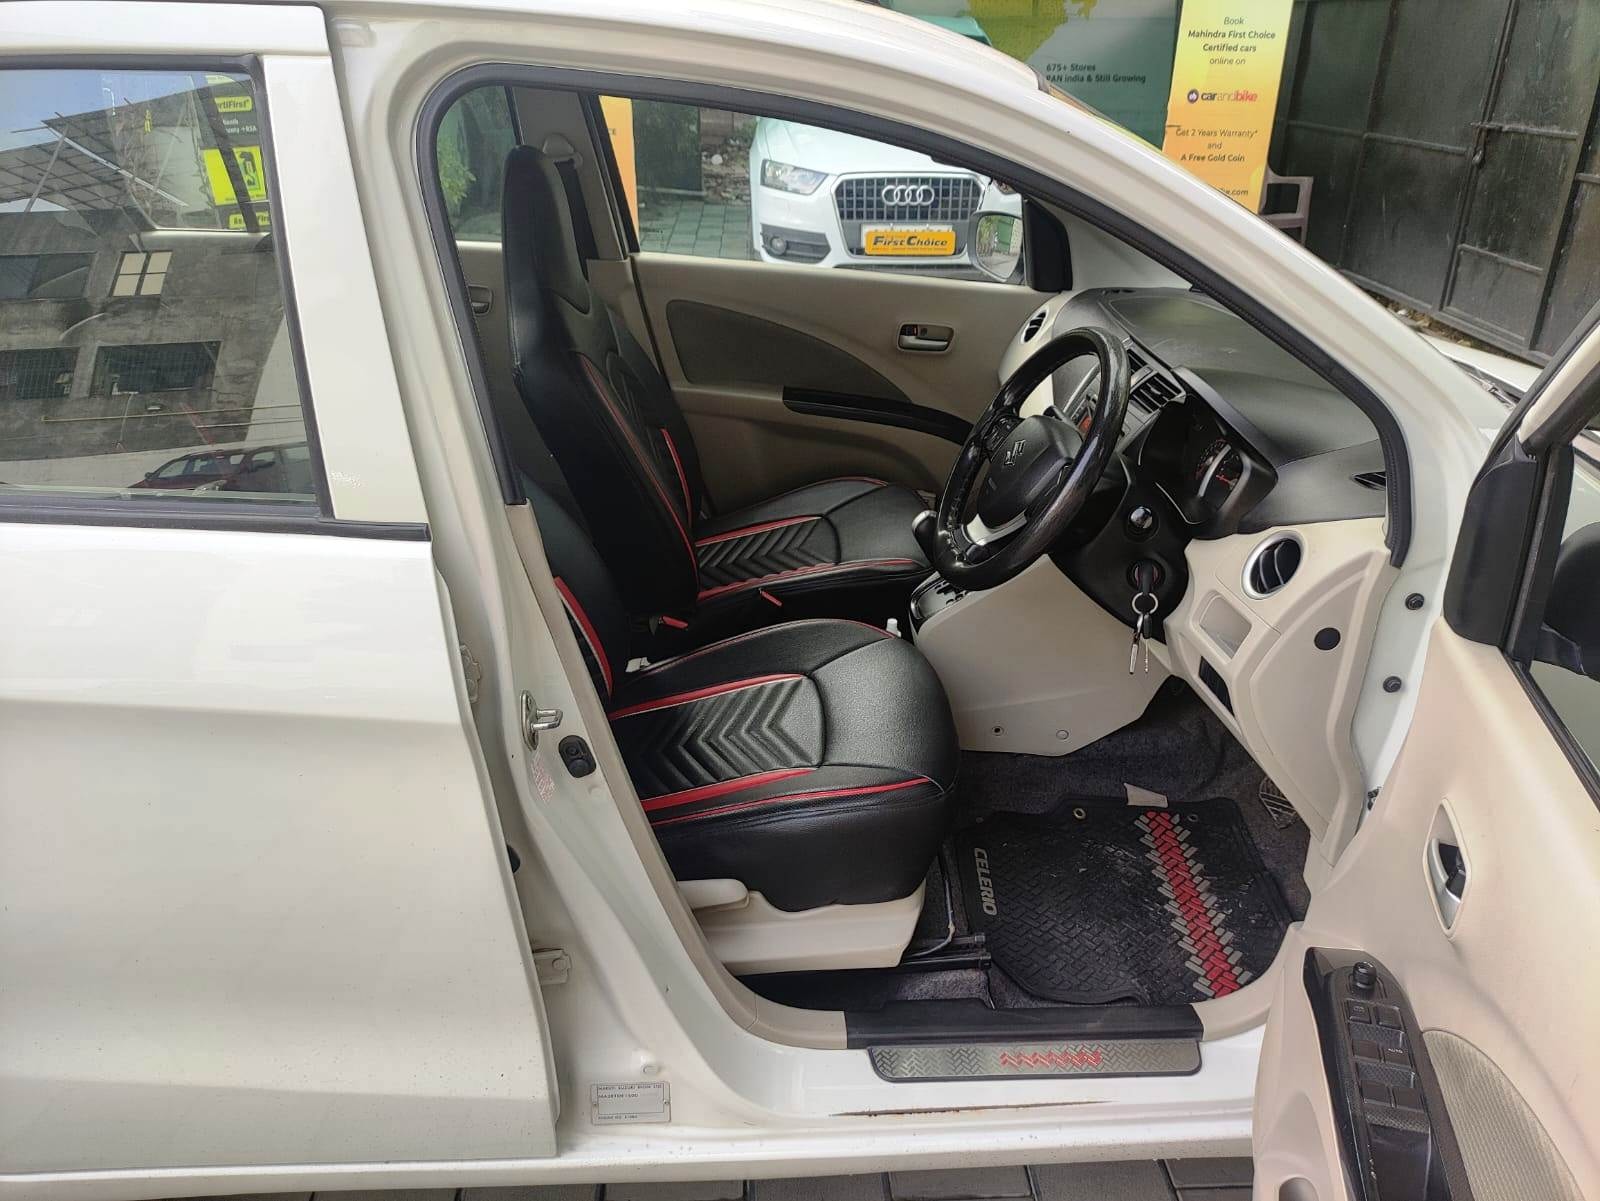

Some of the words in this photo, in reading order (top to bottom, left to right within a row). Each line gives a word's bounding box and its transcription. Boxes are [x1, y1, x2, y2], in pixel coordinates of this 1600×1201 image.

[1223, 16, 1244, 25] Book
[1188, 29, 1226, 39] Mahindra
[1228, 30, 1246, 39] First
[1248, 30, 1276, 39] Choice
[1203, 43, 1238, 52] Certified
[1209, 57, 1234, 65] online
[1046, 63, 1067, 72] 675+
[1070, 63, 1096, 72] Stores
[1087, 74, 1093, 82] &
[1095, 74, 1110, 83] Still
[1112, 74, 1146, 84] Growing
[1176, 128, 1190, 136] Get
[1207, 154, 1226, 162] Gold
[1227, 154, 1245, 162] Coin
[974, 847, 997, 916] CELERIO
